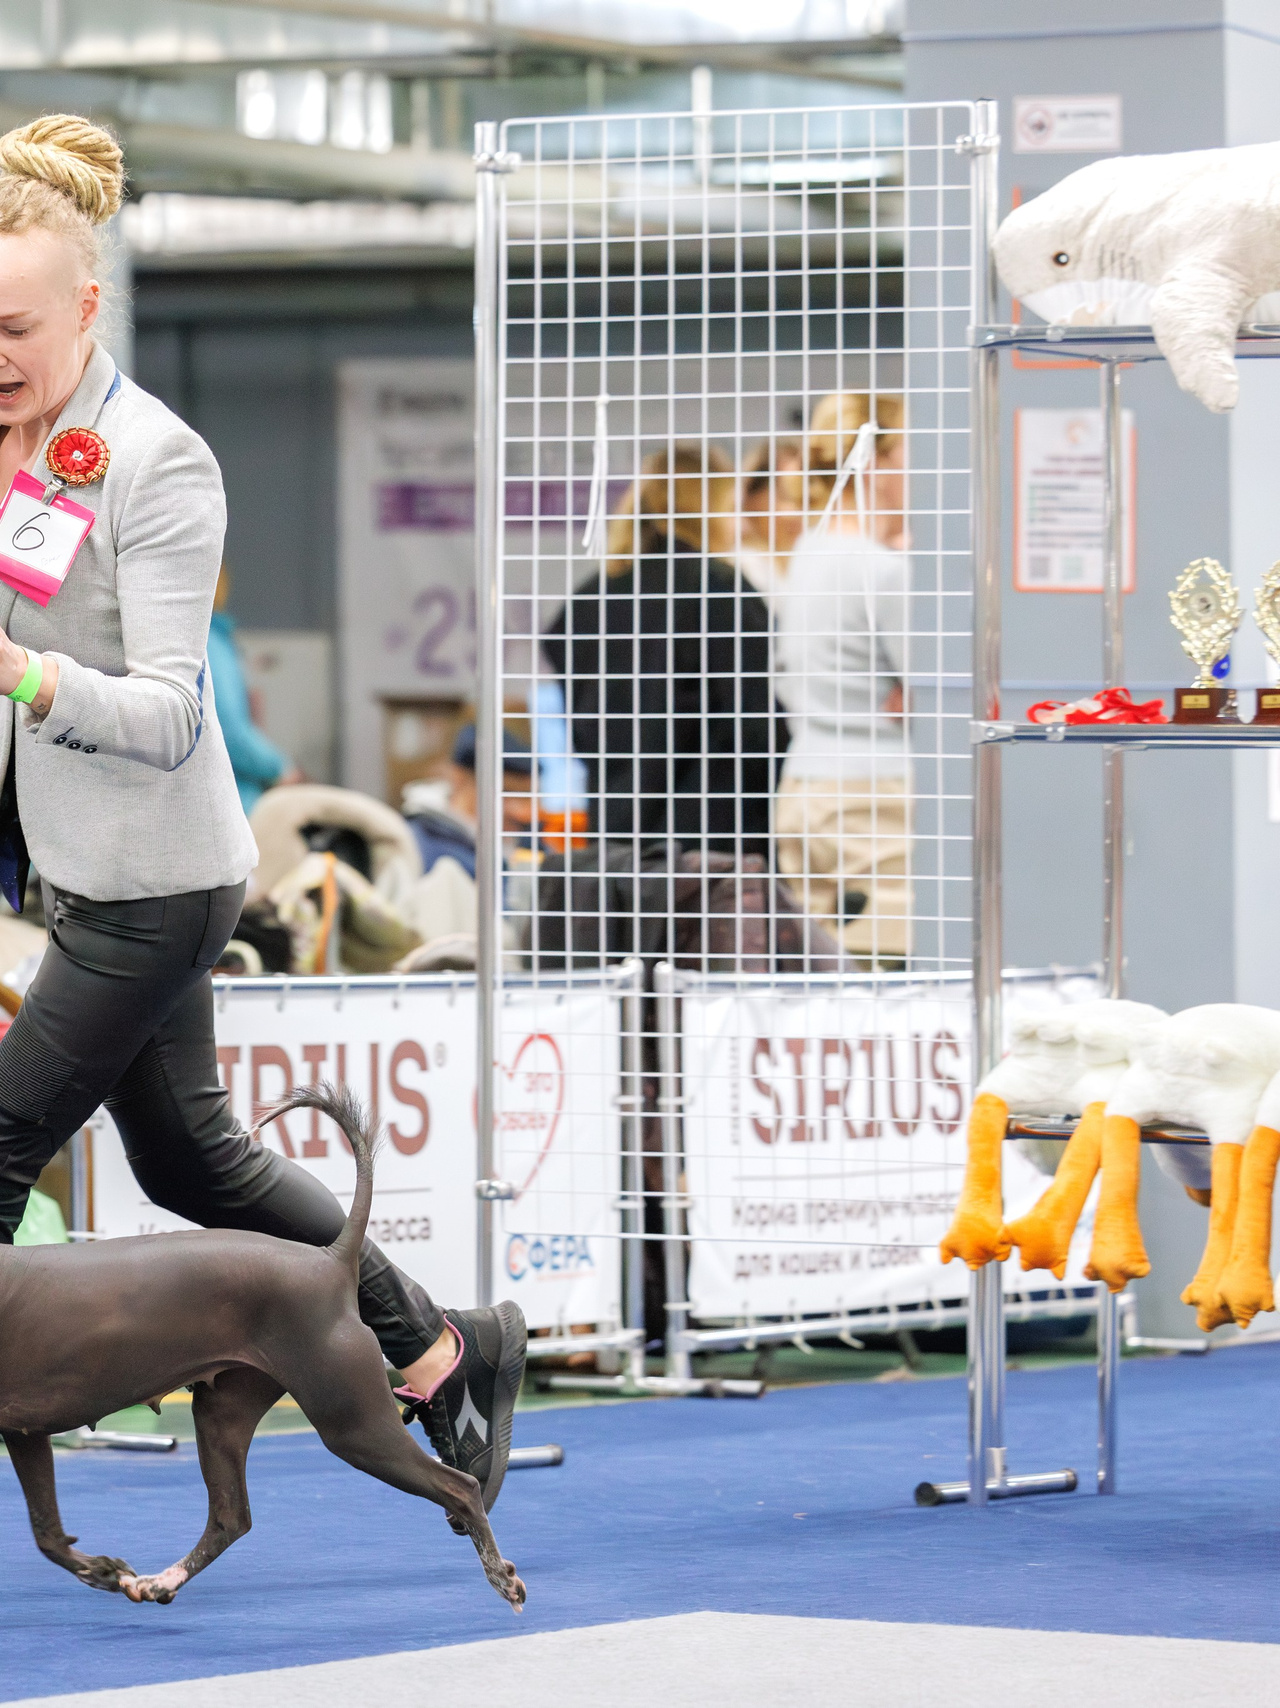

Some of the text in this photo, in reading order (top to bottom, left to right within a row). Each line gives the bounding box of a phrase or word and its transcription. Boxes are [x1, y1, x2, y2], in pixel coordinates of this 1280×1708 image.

[12, 512, 51, 551] 6
[216, 1039, 432, 1160] IRIUS
[750, 1031, 964, 1145] SIRIUS
[732, 1197, 797, 1234] Корма
[505, 1233, 595, 1281] СФЕРА
[735, 1236, 920, 1281] для кошек и собак
